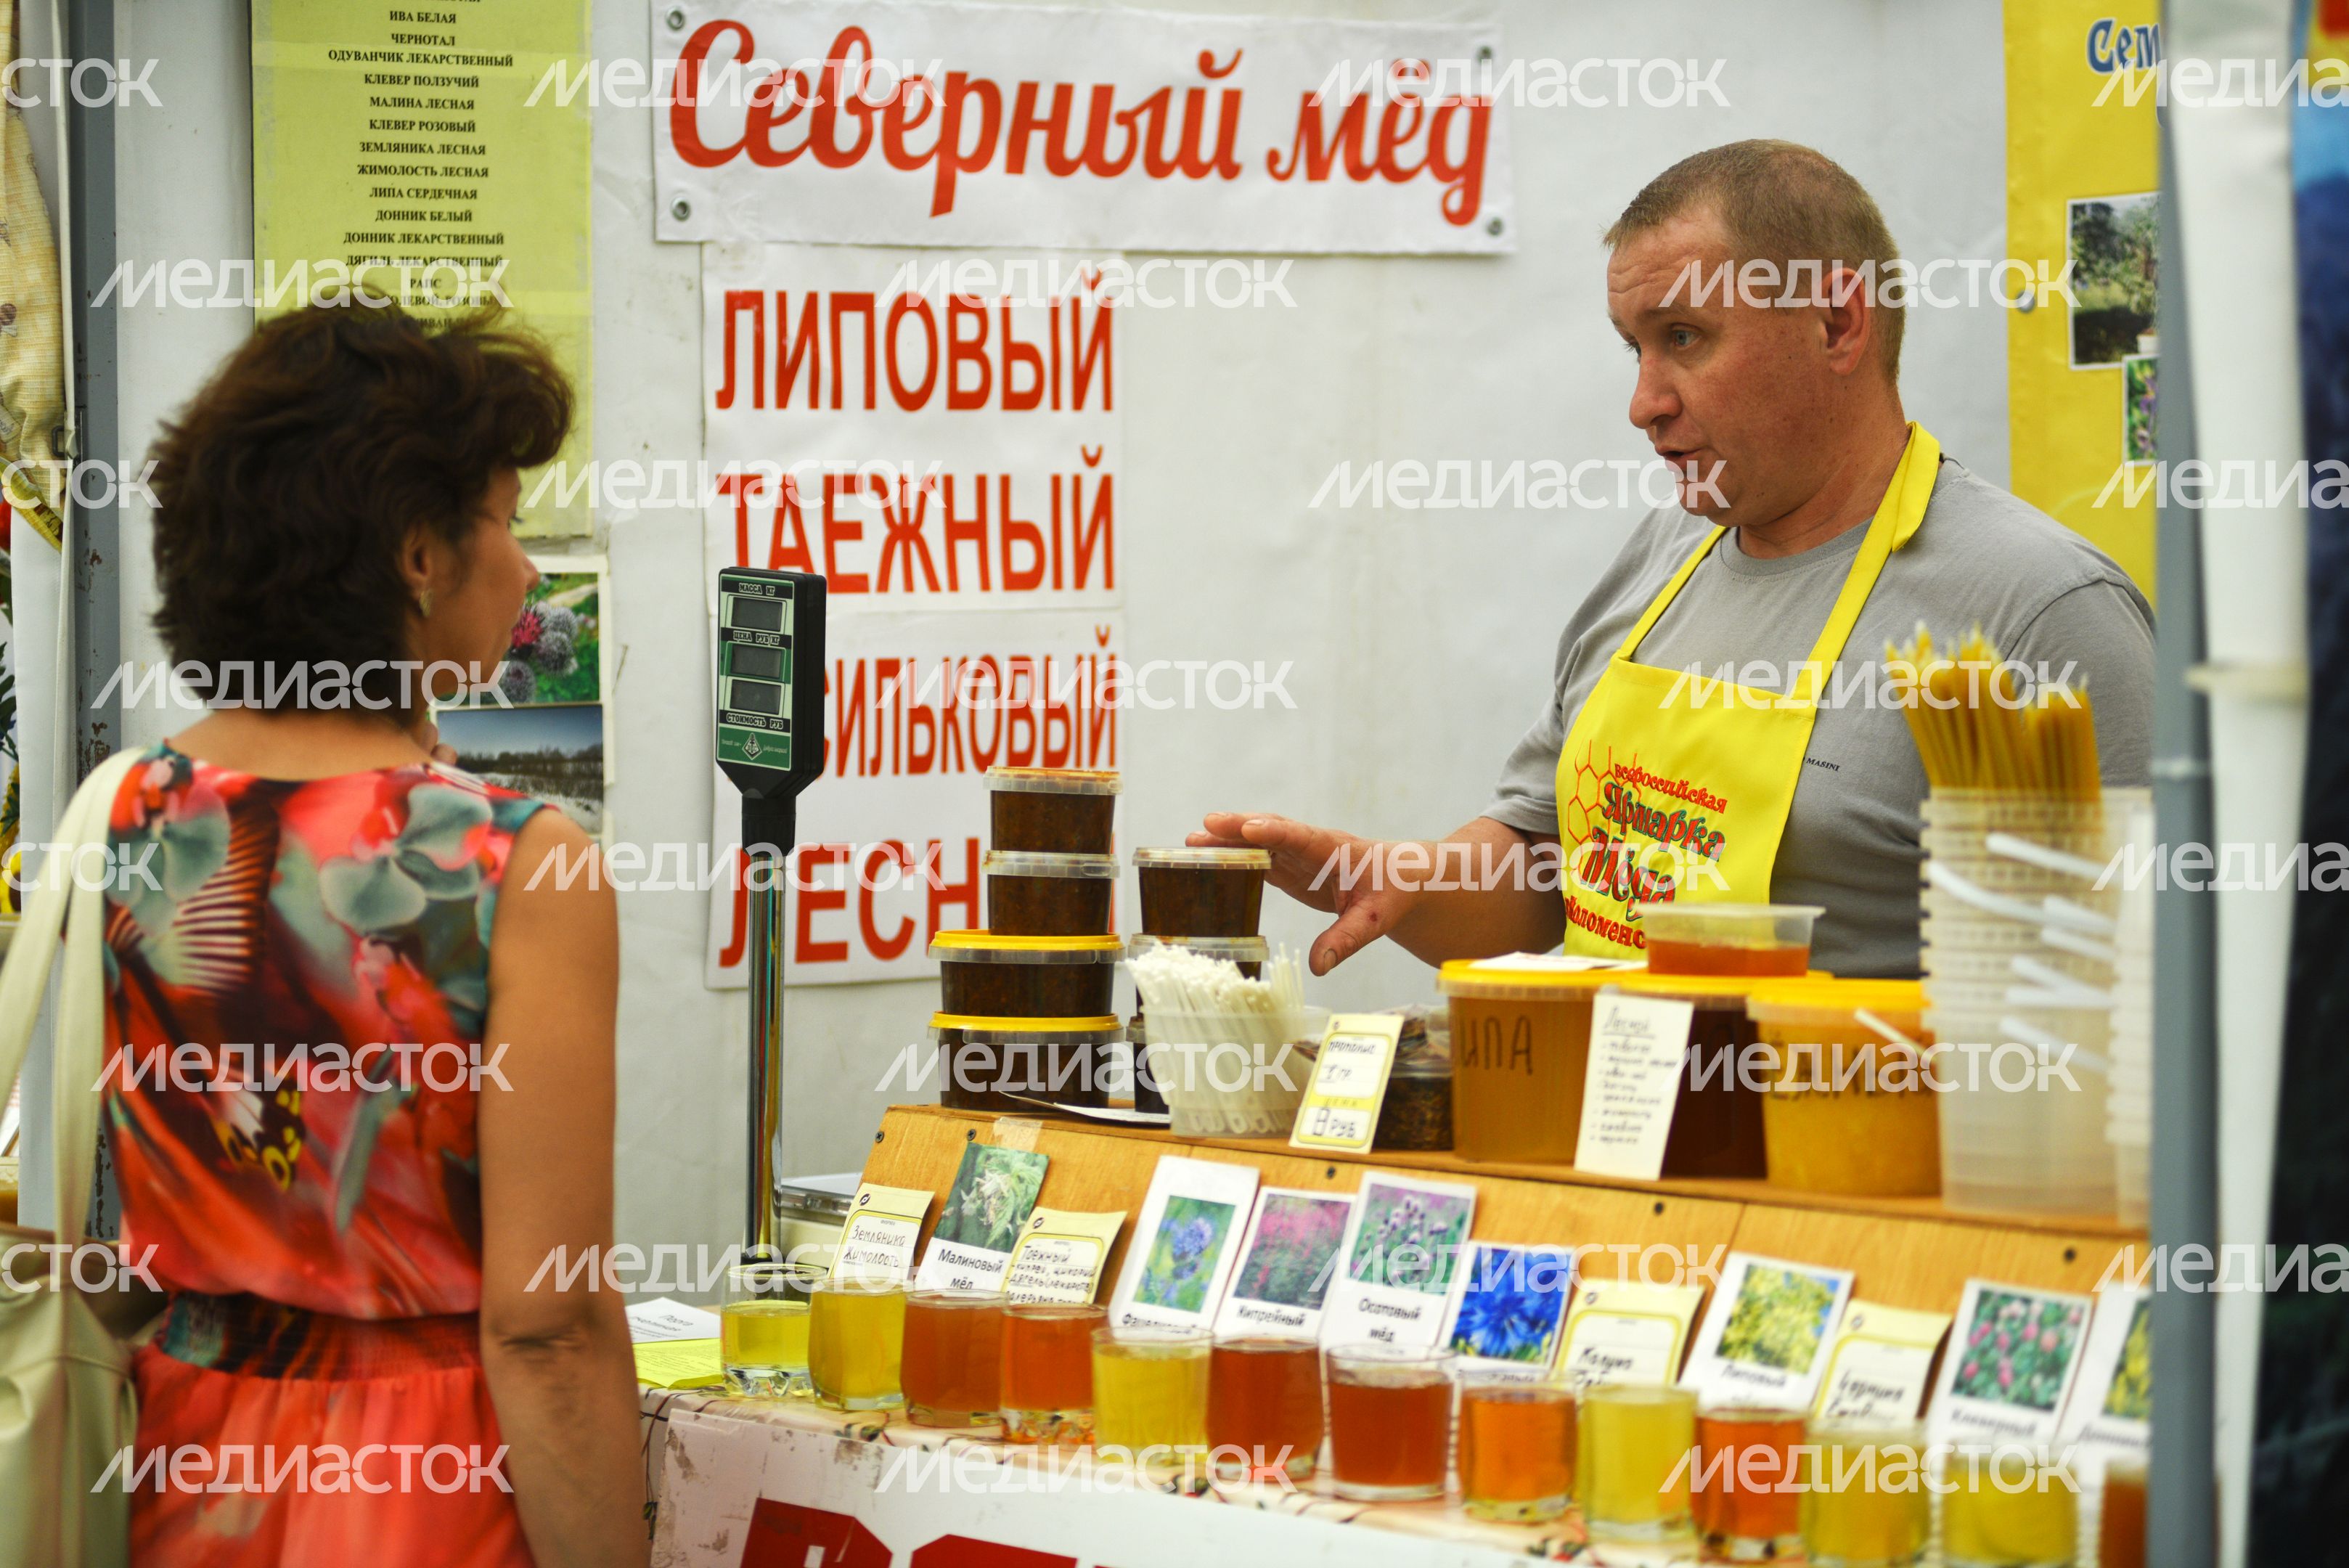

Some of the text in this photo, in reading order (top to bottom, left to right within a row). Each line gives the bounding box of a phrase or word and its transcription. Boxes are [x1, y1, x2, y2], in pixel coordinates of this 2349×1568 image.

[389, 10, 457, 24] ИВА БЕЛАЯ
[391, 33, 456, 46] ЧЕРНОТАЛ
[328, 49, 513, 67] ОДУВАНЧИК ЛЕКАРСТВЕННЫЙ
[364, 73, 479, 88] КЛЕВЕР ПОЛЗУЧИЙ
[369, 96, 475, 110] МАЛИНА ЛЕСНАЯ
[369, 118, 476, 133] КЛЕВЕР РОЗОВЫЙ
[669, 19, 1492, 228] Северный мёд
[359, 142, 486, 155] ЗЕМЛЯНИКА ЛЕСНАЯ
[356, 164, 489, 178] ЖИМОЛОСТЬ ЛЕСНАЯ
[369, 187, 478, 200] ЛИПА СЕРДЕЧНАЯ
[375, 209, 473, 222] ДОННИК БЕЛЫЙ
[343, 232, 504, 245] ДОННИК ЛЕКАРСТВЕННЫЙ
[345, 255, 503, 268] ДЯГИЛЬ ЛЕКАРСТВЕННЫЙ
[716, 267, 1114, 413] ЛИПОВЫЙ
[716, 444, 1115, 595] ТАЕЖНЫЙ
[739, 583, 775, 596] МАССА КГ
[733, 630, 780, 645] ЦЕНА РУБ/КГ
[822, 624, 1118, 781] ИЛЬКОВЫЙ
[727, 714, 783, 730] СТОИМОСТЬ РУБ
[1806, 757, 1841, 772] MASINI
[1601, 781, 1725, 862] Ярмарка
[938, 1248, 1004, 1274] Малиновый
